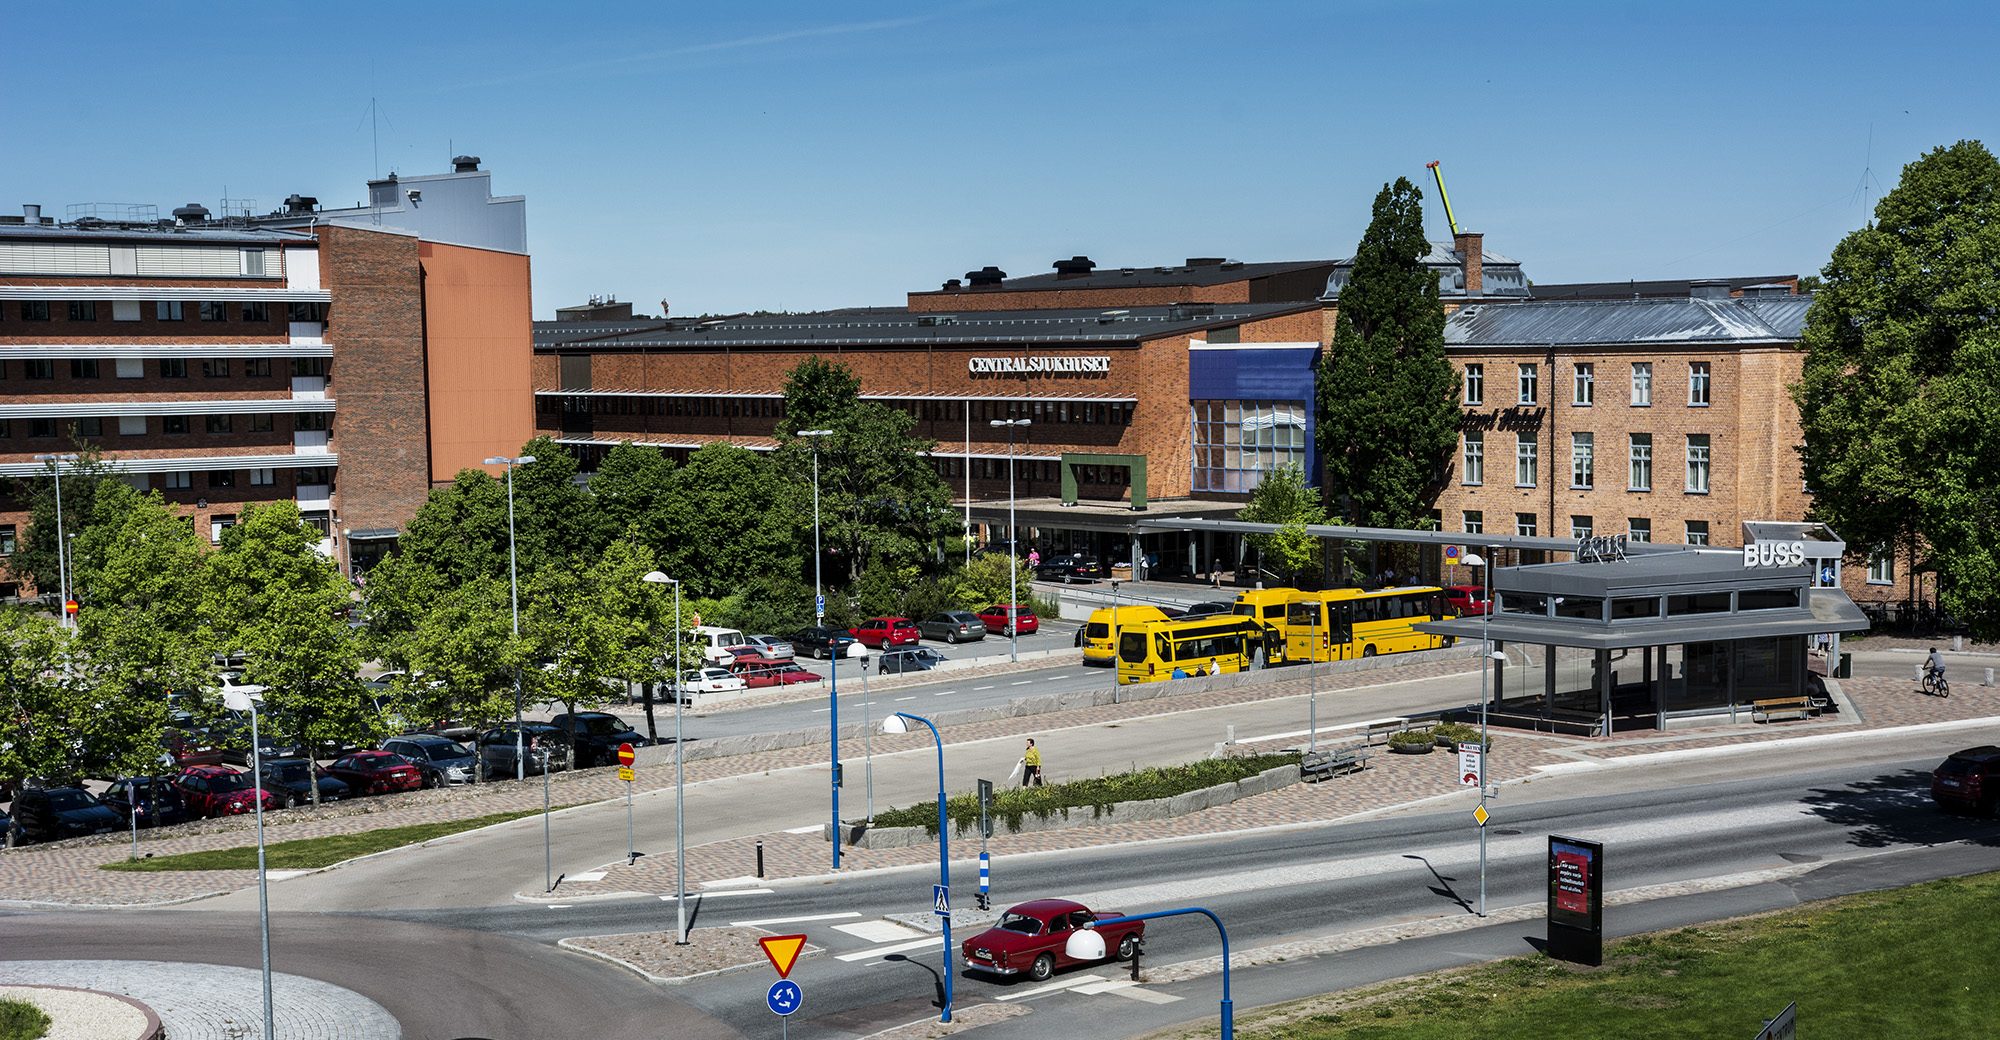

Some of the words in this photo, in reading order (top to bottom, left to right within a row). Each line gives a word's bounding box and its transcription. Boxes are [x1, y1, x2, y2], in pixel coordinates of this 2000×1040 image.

[968, 356, 1111, 373] CENTRALSJUKHUSET
[1499, 406, 1547, 427] Hotell
[1743, 541, 1805, 567] BUSS
